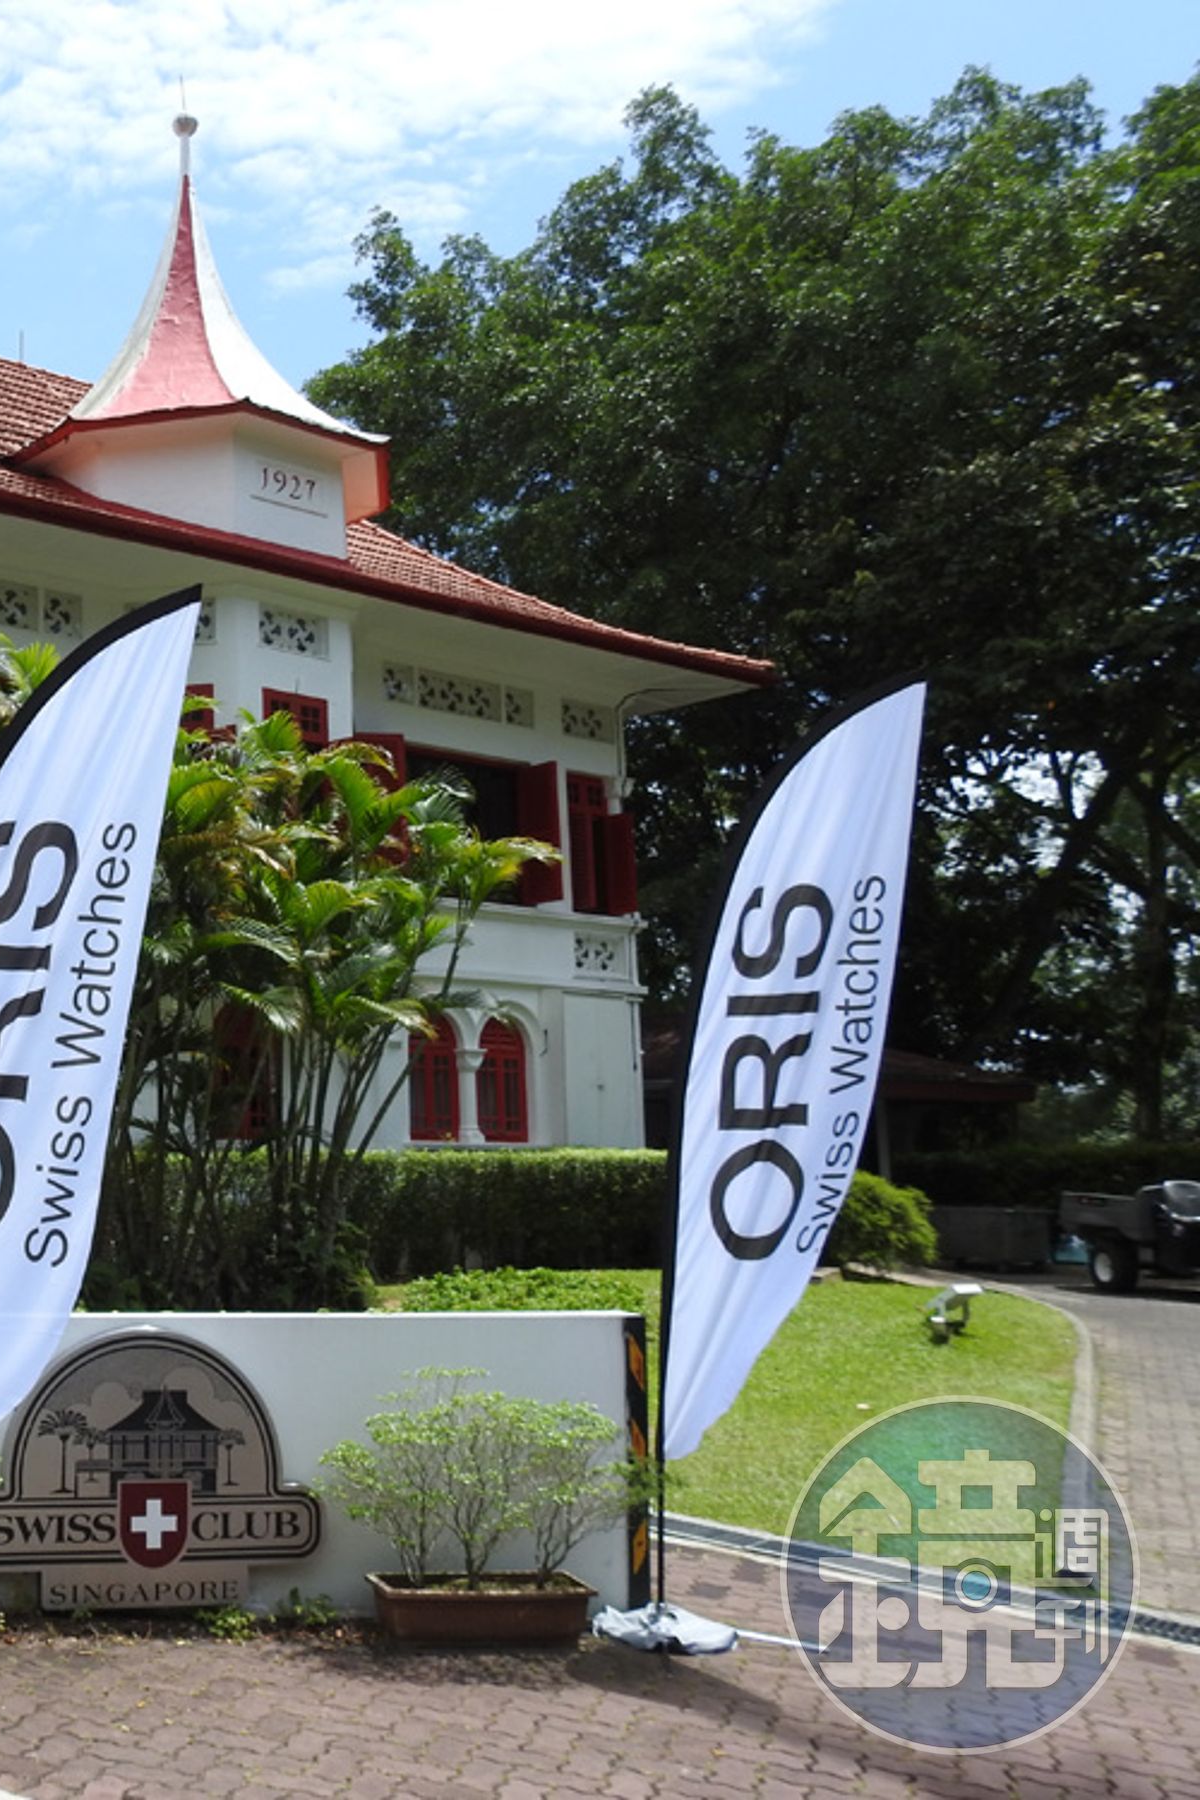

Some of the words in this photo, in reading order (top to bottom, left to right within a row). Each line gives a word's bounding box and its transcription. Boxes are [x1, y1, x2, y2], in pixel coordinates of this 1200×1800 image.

[260, 466, 317, 501] 1927
[51, 821, 138, 1069] Watches
[710, 883, 834, 1261] ORIS
[796, 1110, 860, 1254] Swiss
[829, 875, 886, 1094] Watches
[25, 1095, 93, 1267] Swiss
[49, 1579, 240, 1606] SINGAPORE
[191, 1511, 301, 1542] CLUB
